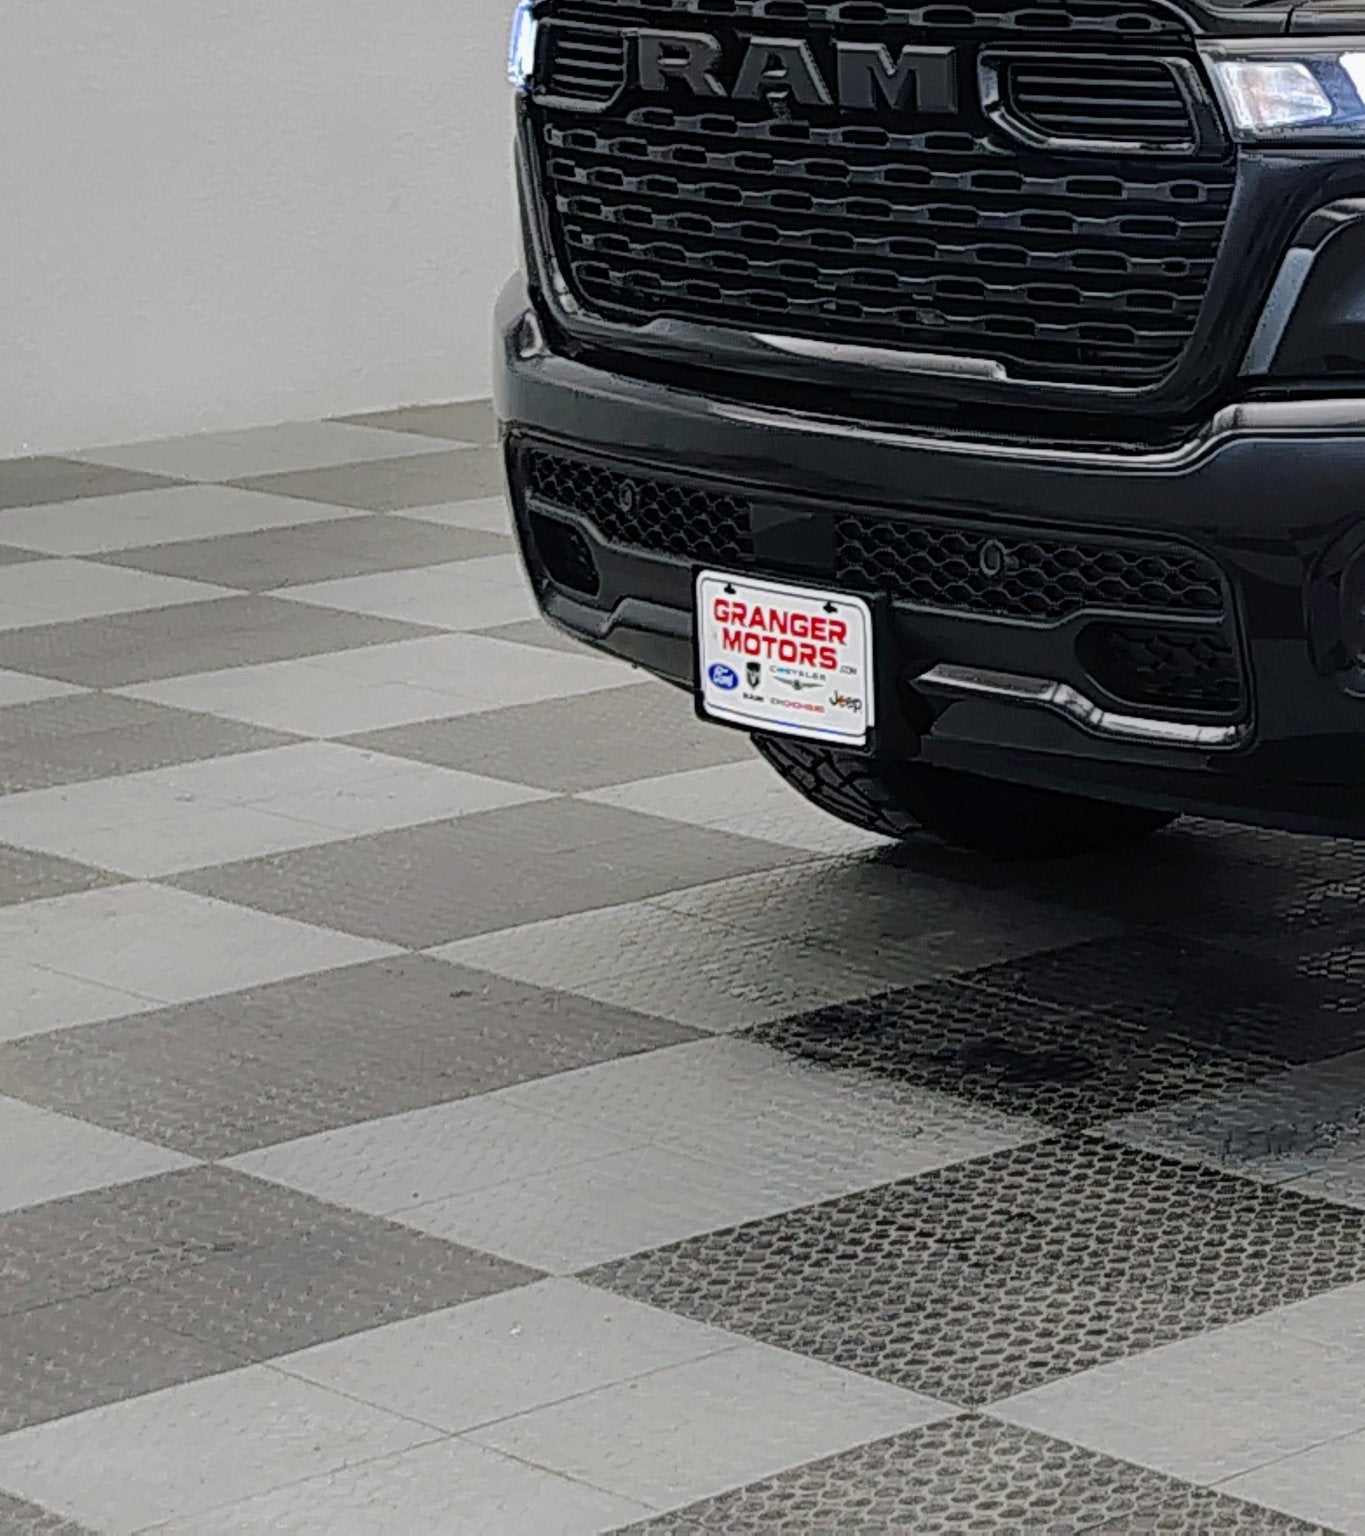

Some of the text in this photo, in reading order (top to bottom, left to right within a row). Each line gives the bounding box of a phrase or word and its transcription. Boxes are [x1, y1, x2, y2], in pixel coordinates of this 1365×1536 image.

[634, 29, 957, 114] RAM
[714, 598, 847, 645] GRANGER
[722, 628, 838, 670] MOTORS
[830, 690, 862, 712] Jeep
